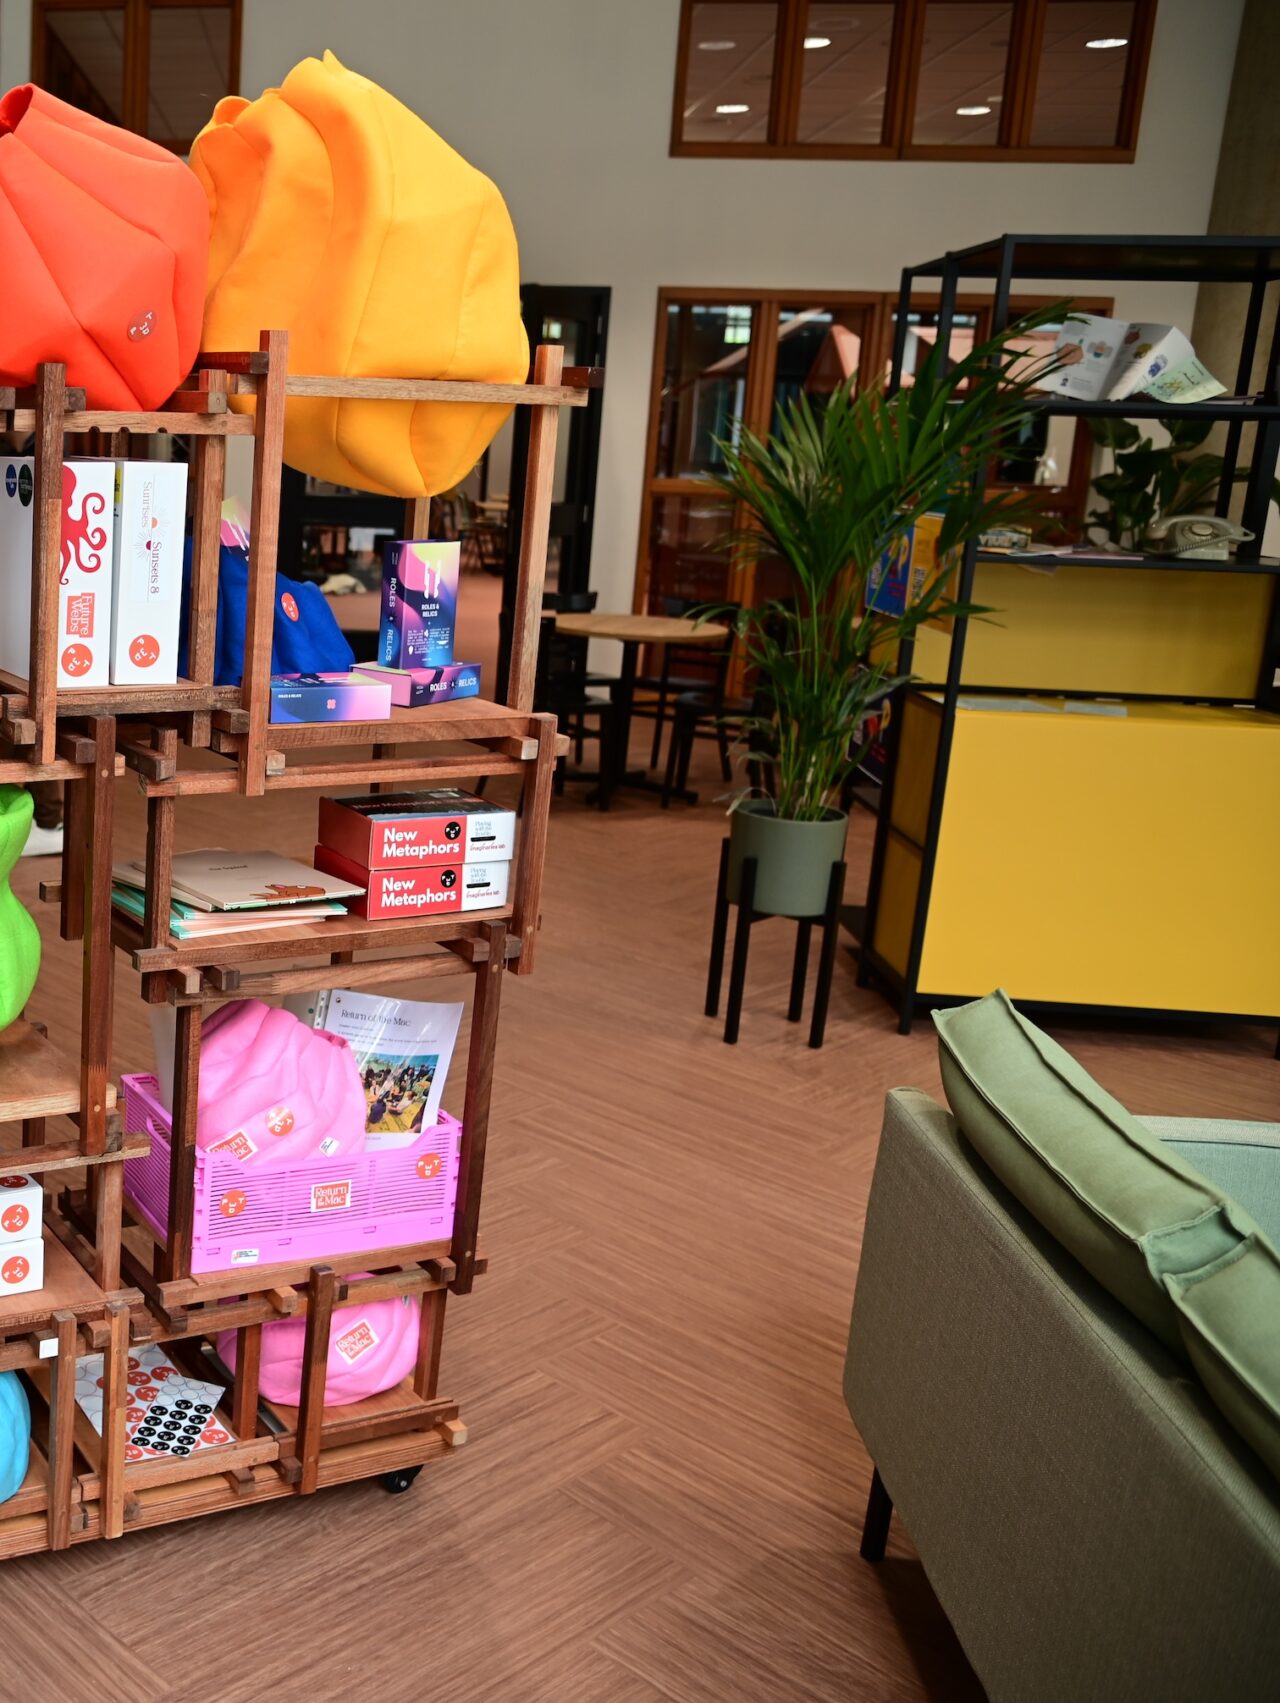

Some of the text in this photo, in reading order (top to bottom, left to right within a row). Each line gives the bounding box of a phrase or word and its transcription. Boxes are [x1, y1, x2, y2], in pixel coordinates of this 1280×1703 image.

[142, 481, 153, 528] Sunrises
[150, 541, 162, 584] Sunsets
[389, 577, 397, 608] ROLES
[70, 600, 81, 634] Webs
[80, 595, 92, 636] Future
[385, 629, 394, 661] RELICS
[429, 682, 447, 692] ROLES
[458, 677, 477, 688] RELICS
[383, 828, 418, 842] New
[382, 842, 460, 859] Metaphors
[381, 878, 415, 892] New
[381, 890, 456, 908] Metaphors
[341, 1009, 366, 1020] Return
